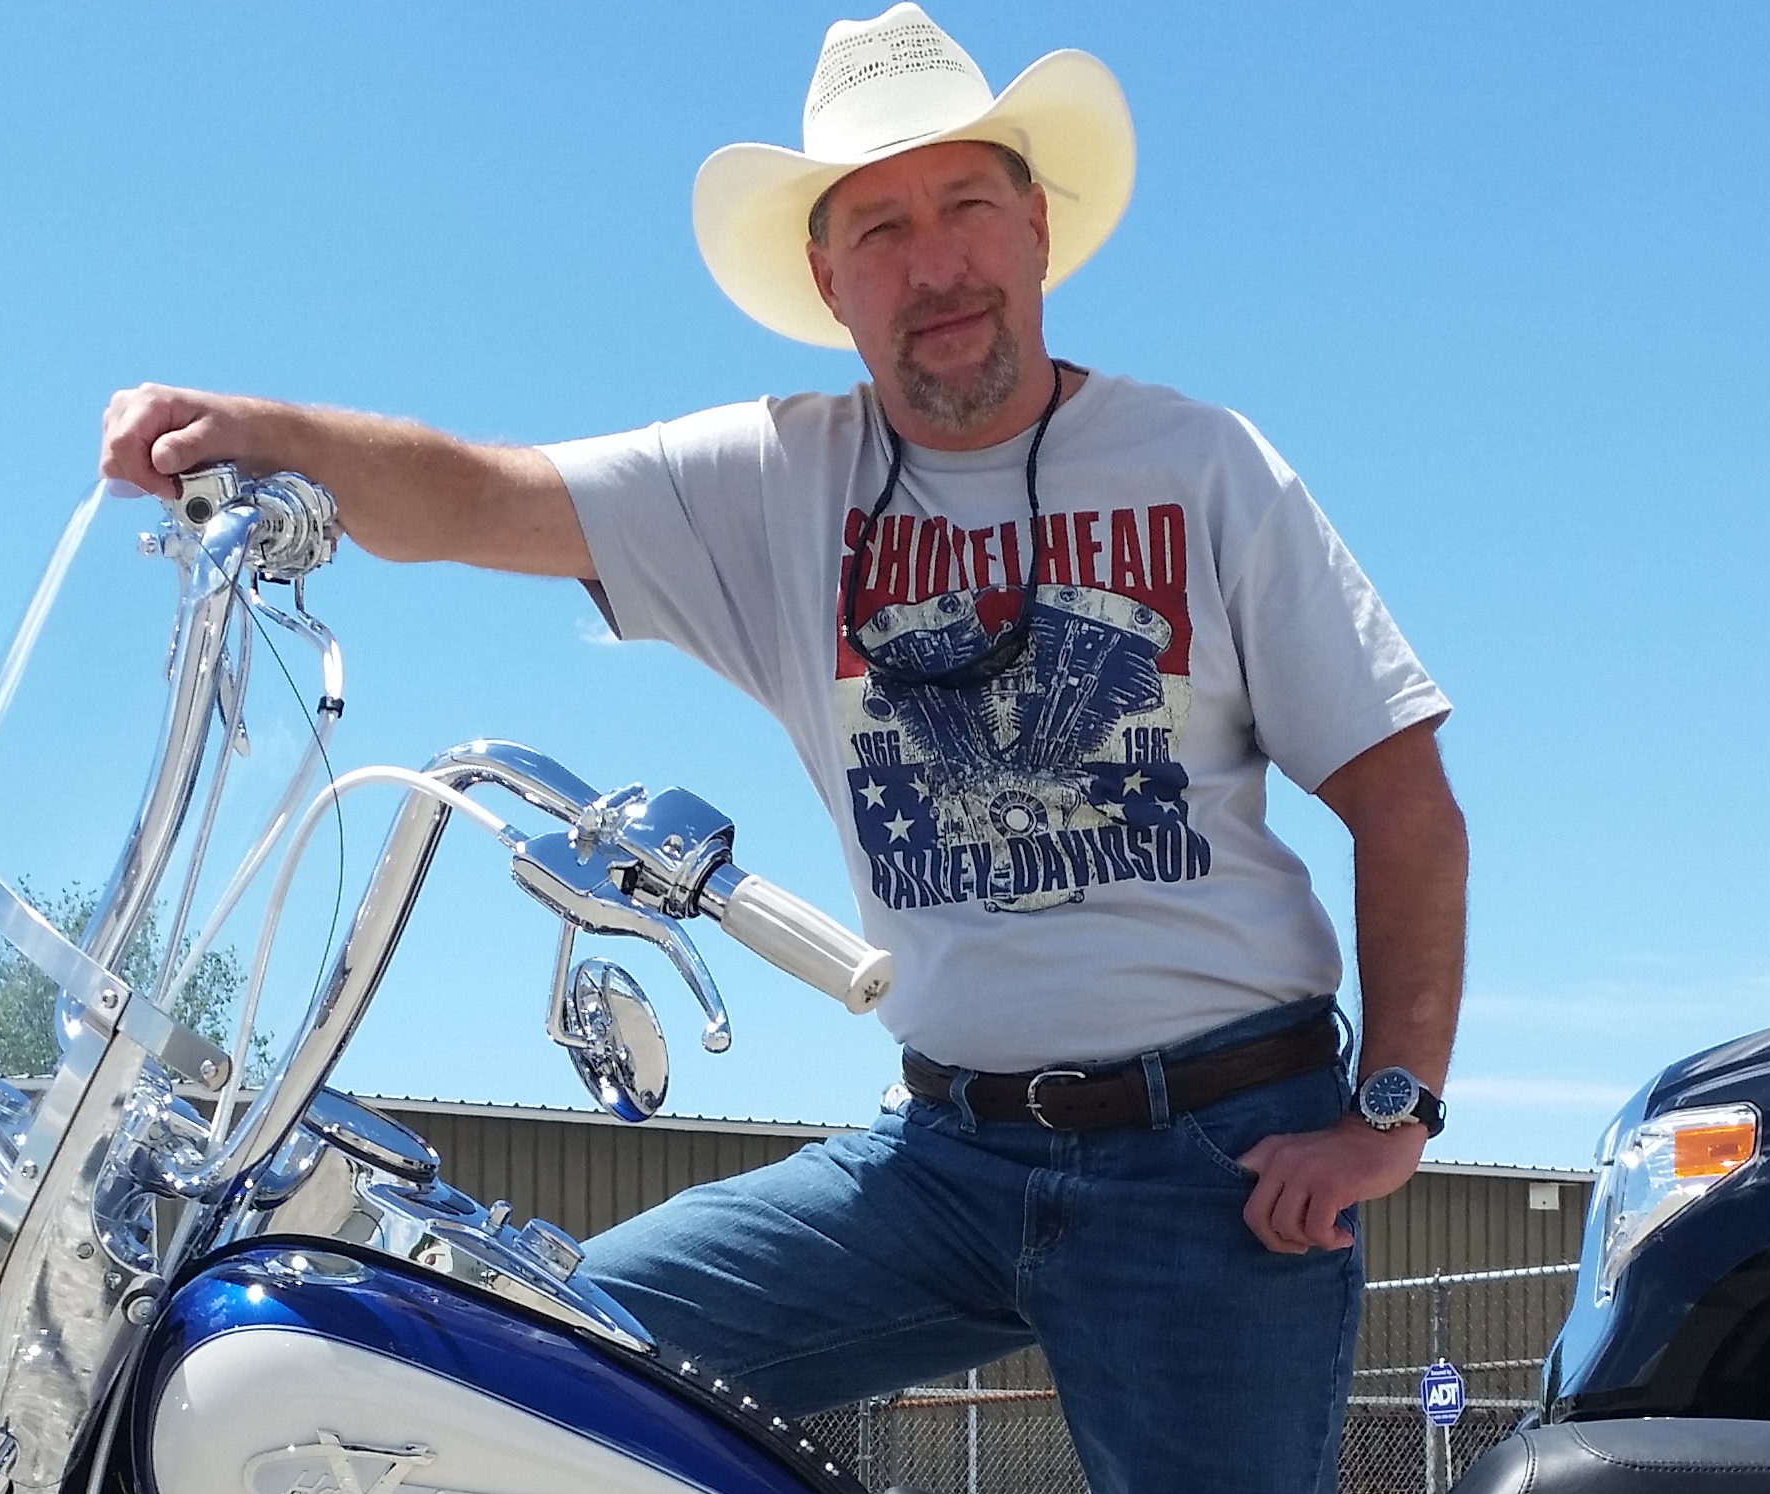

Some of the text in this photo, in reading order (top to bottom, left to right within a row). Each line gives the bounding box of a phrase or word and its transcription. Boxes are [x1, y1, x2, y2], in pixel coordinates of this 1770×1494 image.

[850, 730, 901, 767] 1966
[1122, 726, 1172, 764] 1985
[1429, 1382, 1459, 1407] ADT
